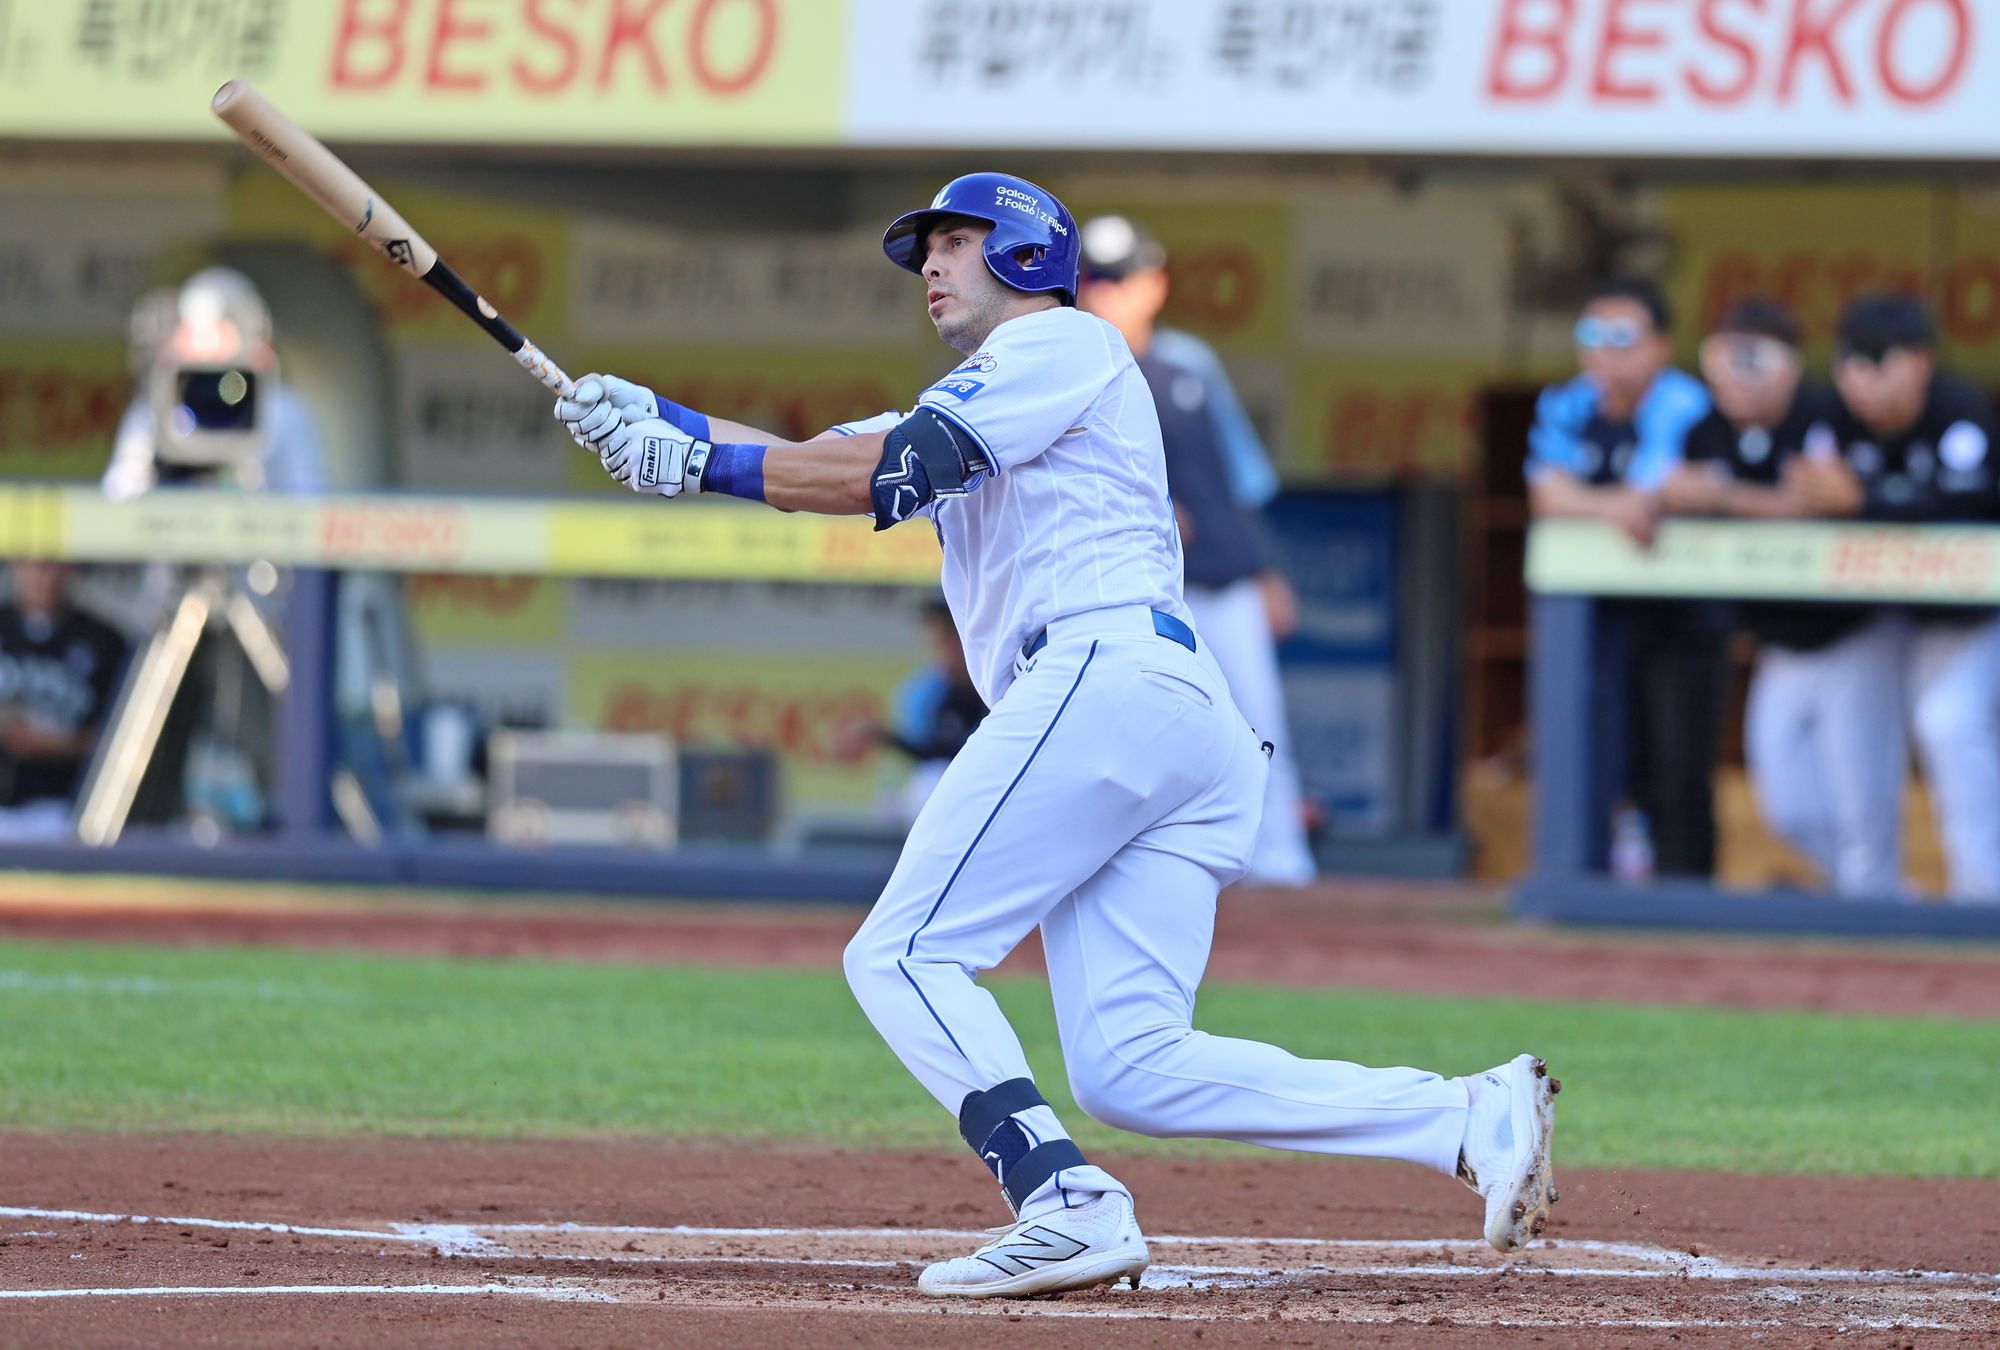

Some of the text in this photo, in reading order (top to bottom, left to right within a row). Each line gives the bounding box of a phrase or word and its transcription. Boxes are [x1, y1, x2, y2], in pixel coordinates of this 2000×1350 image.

[330, 0, 779, 95] BESKO
[1487, 0, 1973, 103] BESKO
[995, 196, 1068, 236] Z Fold6 Z Flip6
[996, 186, 1038, 206] Galaxy
